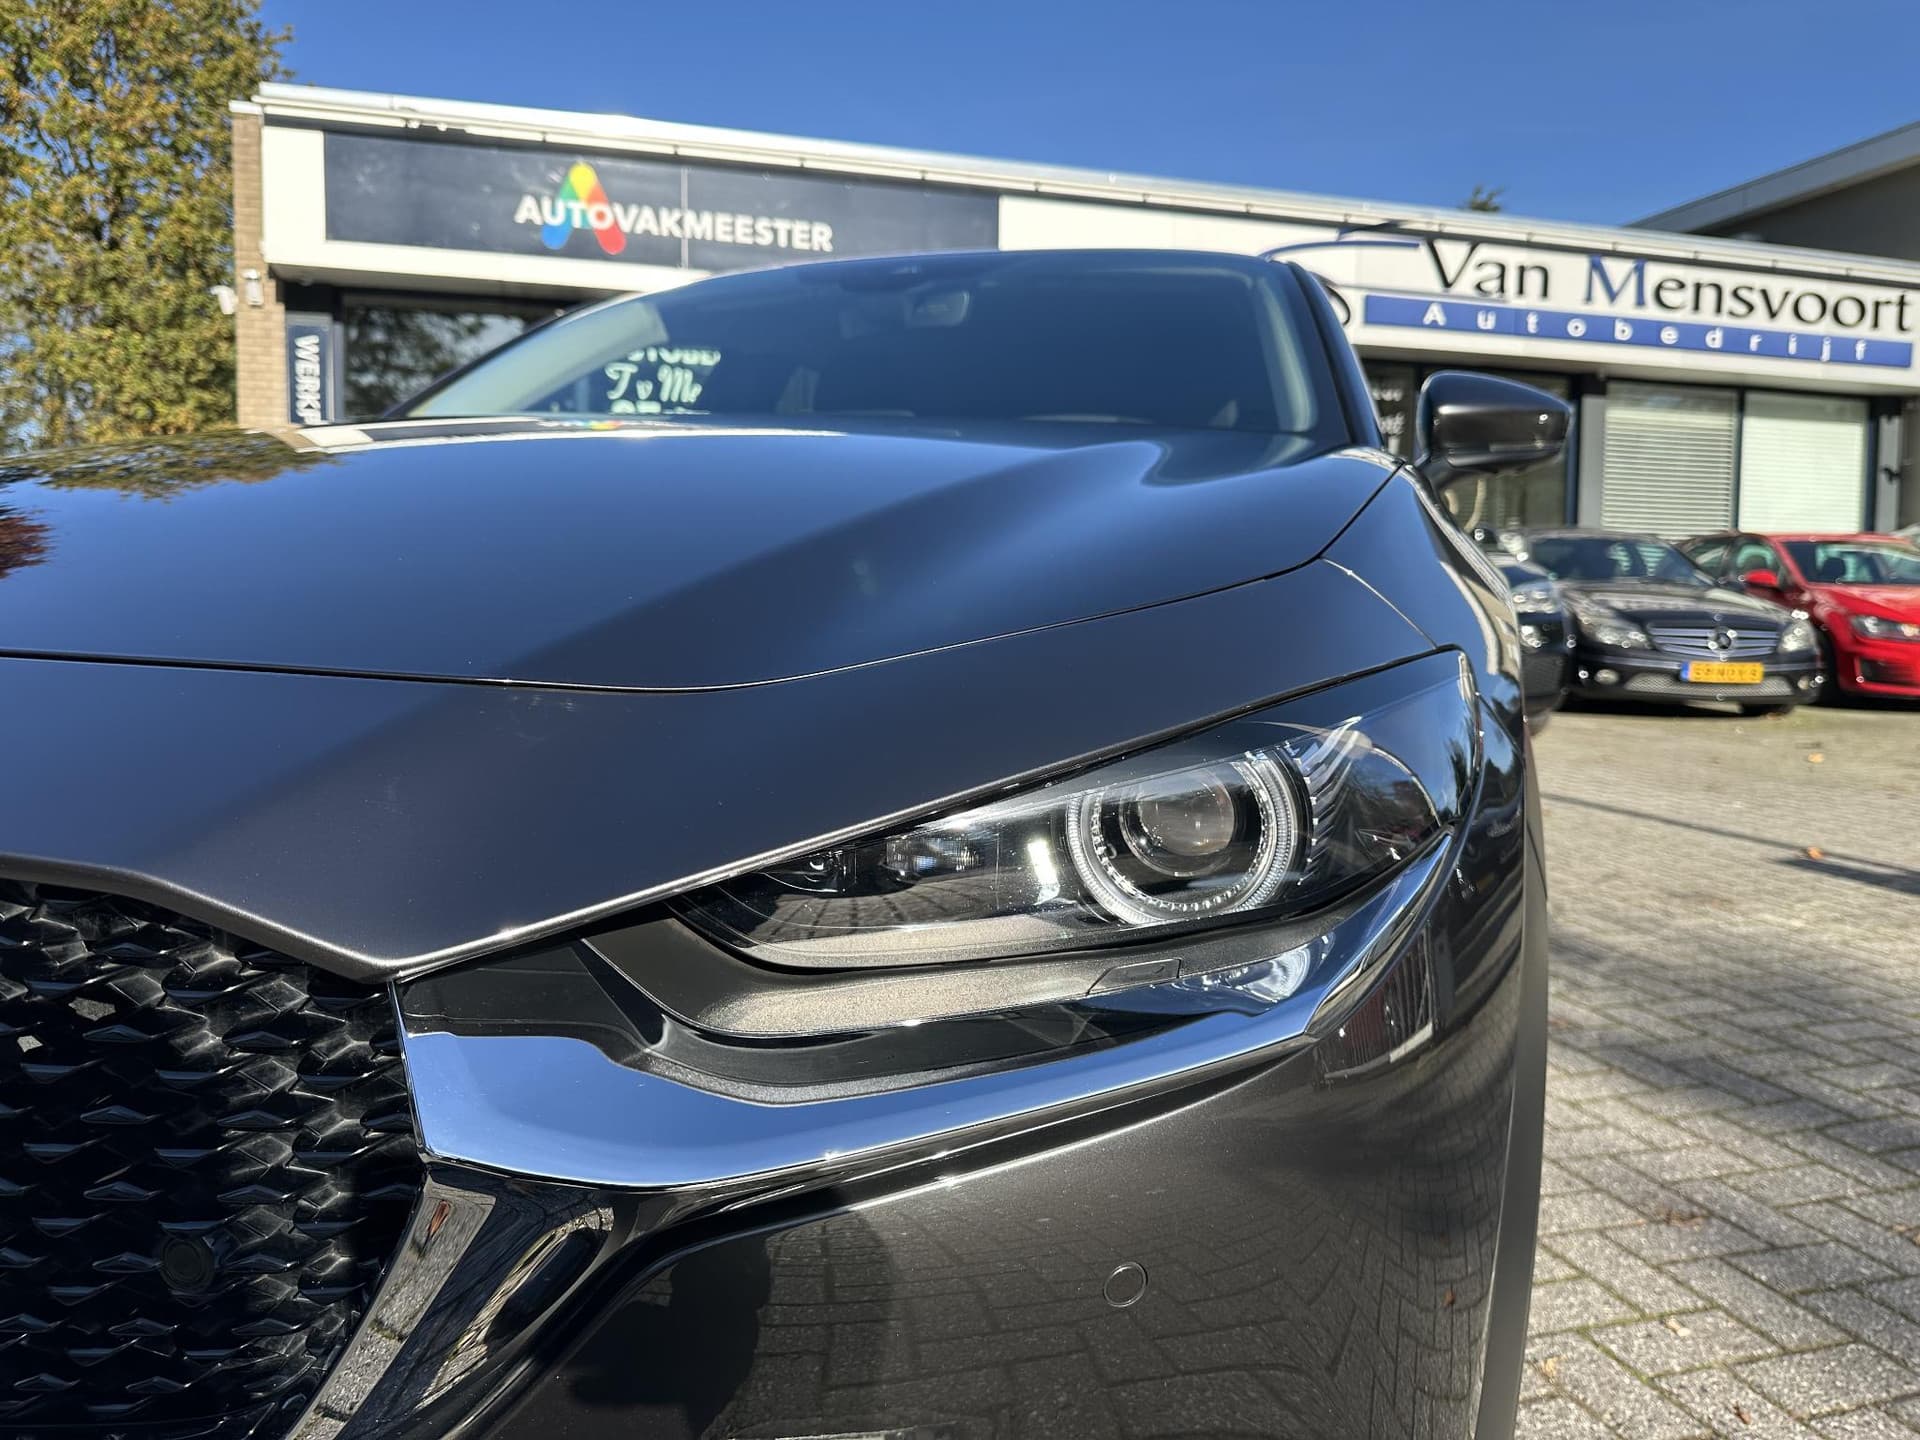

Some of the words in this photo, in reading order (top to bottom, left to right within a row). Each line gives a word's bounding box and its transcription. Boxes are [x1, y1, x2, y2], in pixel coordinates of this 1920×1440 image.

[513, 194, 833, 253] AUTOVAKMEESTER
[1426, 237, 1550, 300] Van
[1584, 254, 1913, 332] Mensvoort
[1422, 303, 1867, 363] Autobedrijf
